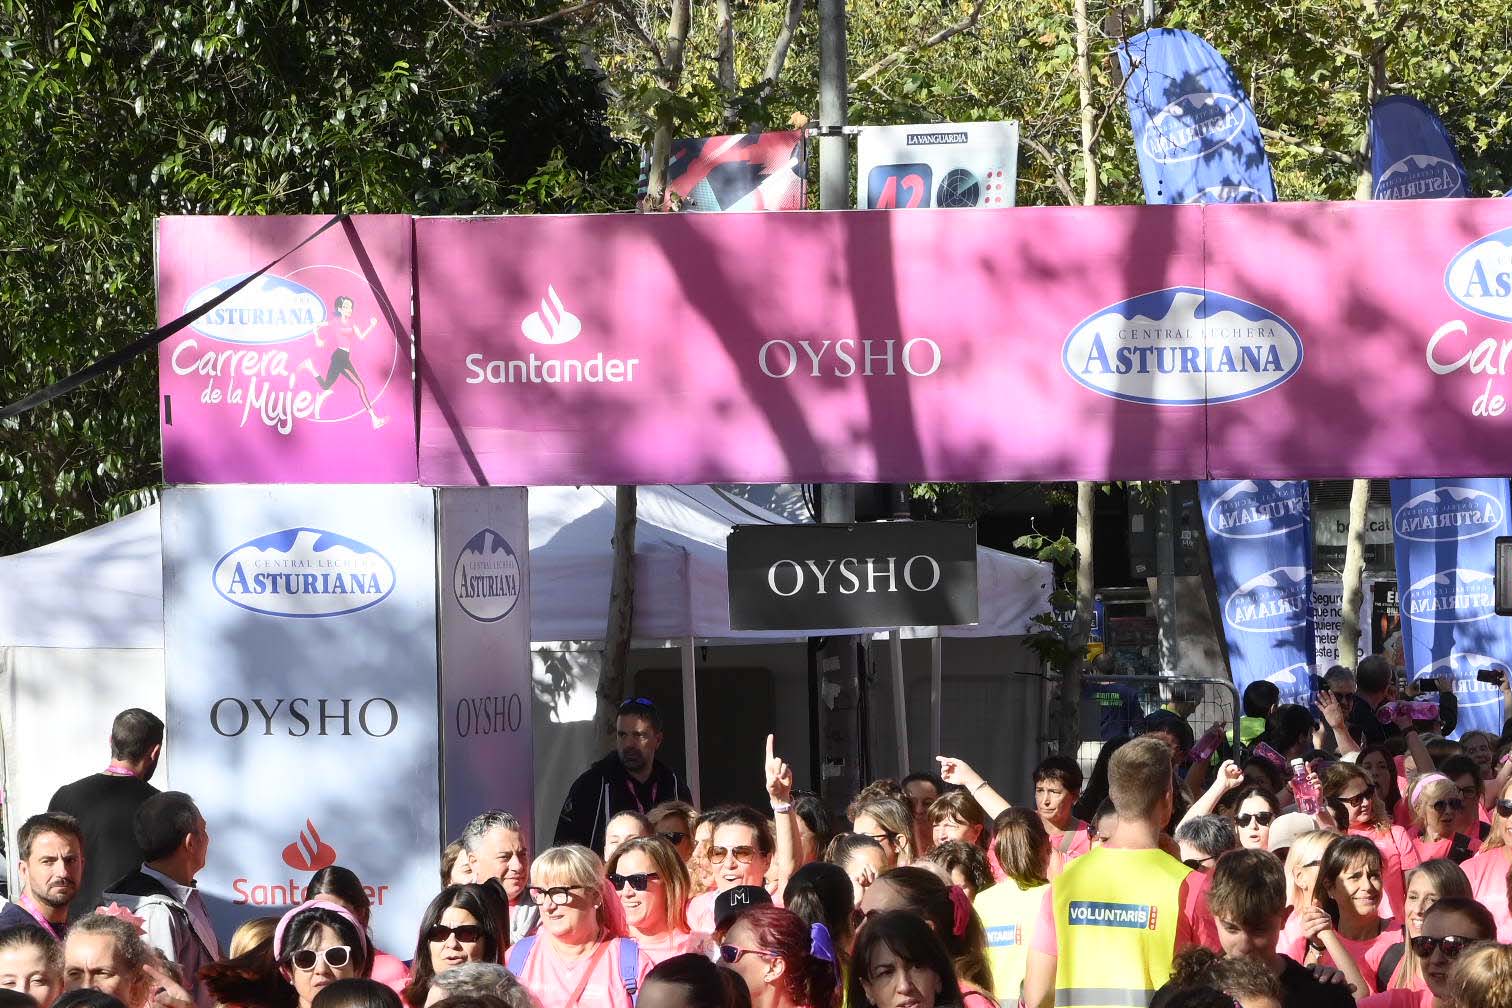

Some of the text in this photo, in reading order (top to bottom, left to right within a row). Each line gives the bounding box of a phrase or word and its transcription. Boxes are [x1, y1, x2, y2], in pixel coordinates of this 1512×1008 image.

[917, 134, 967, 144] VANGUARDIA
[1117, 328, 1192, 339] CENTRAL
[171, 338, 290, 377] Carrera
[465, 353, 639, 384] Santander
[757, 337, 942, 379] OYSHO
[1081, 331, 1285, 375] ASTURIANA
[200, 376, 243, 405] de la
[240, 372, 334, 435] Mujer
[1471, 378, 1506, 418] de
[227, 561, 382, 596] ASTURIANA
[254, 559, 312, 568] CENTRAL
[459, 564, 517, 600] ASTURIANA
[767, 554, 941, 597] OYSHO
[209, 696, 399, 738] OYSHO
[456, 692, 523, 738] OYSHO
[1069, 906, 1147, 923] VOLUNTARIS
